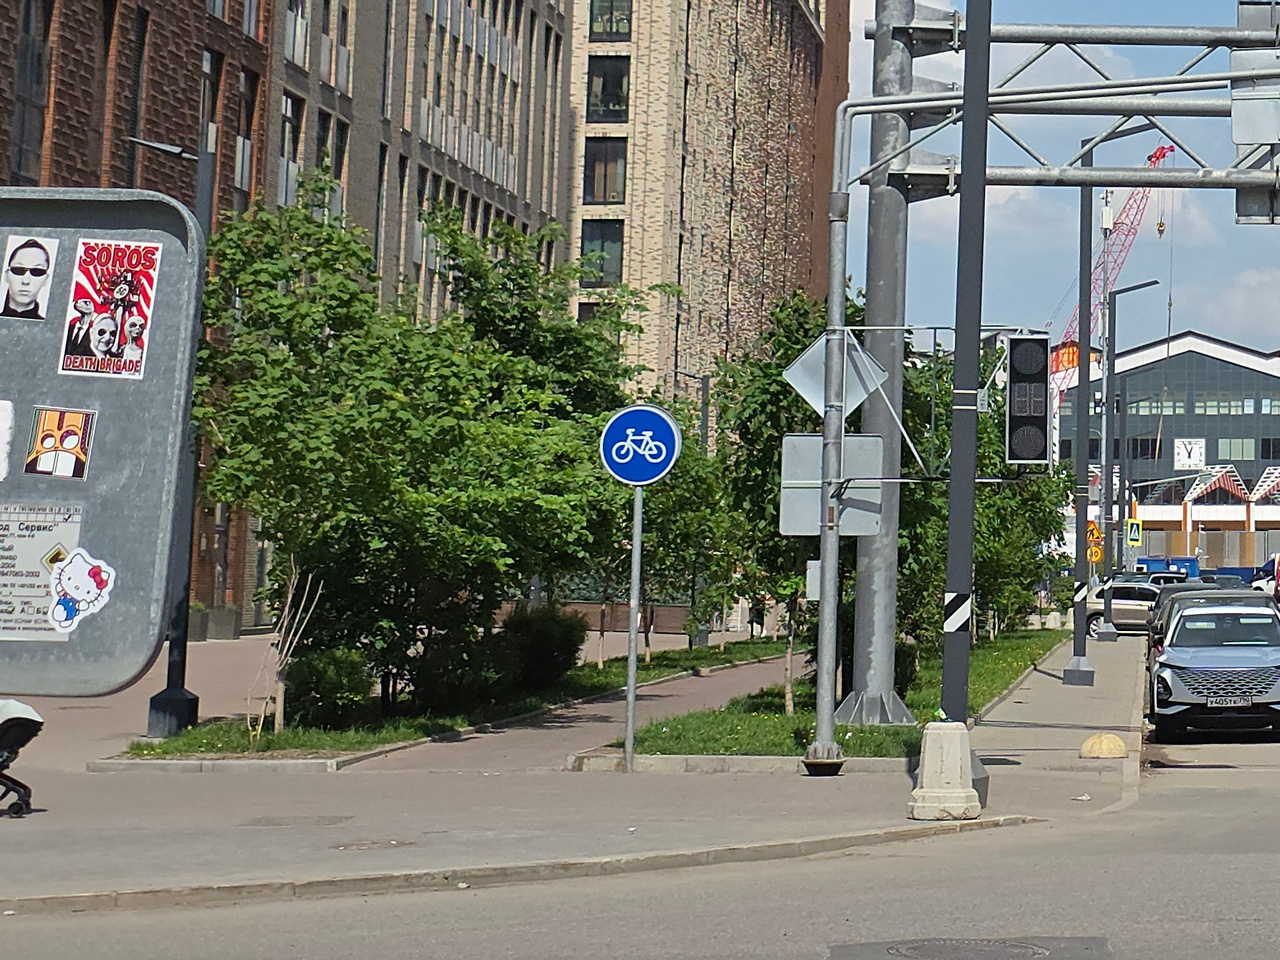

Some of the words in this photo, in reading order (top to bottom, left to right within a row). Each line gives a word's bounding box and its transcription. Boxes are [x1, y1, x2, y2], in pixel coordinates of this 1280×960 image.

[81, 245, 156, 270] SOROS
[64, 355, 97, 371] DEATH
[99, 356, 141, 374] BRIGADE
